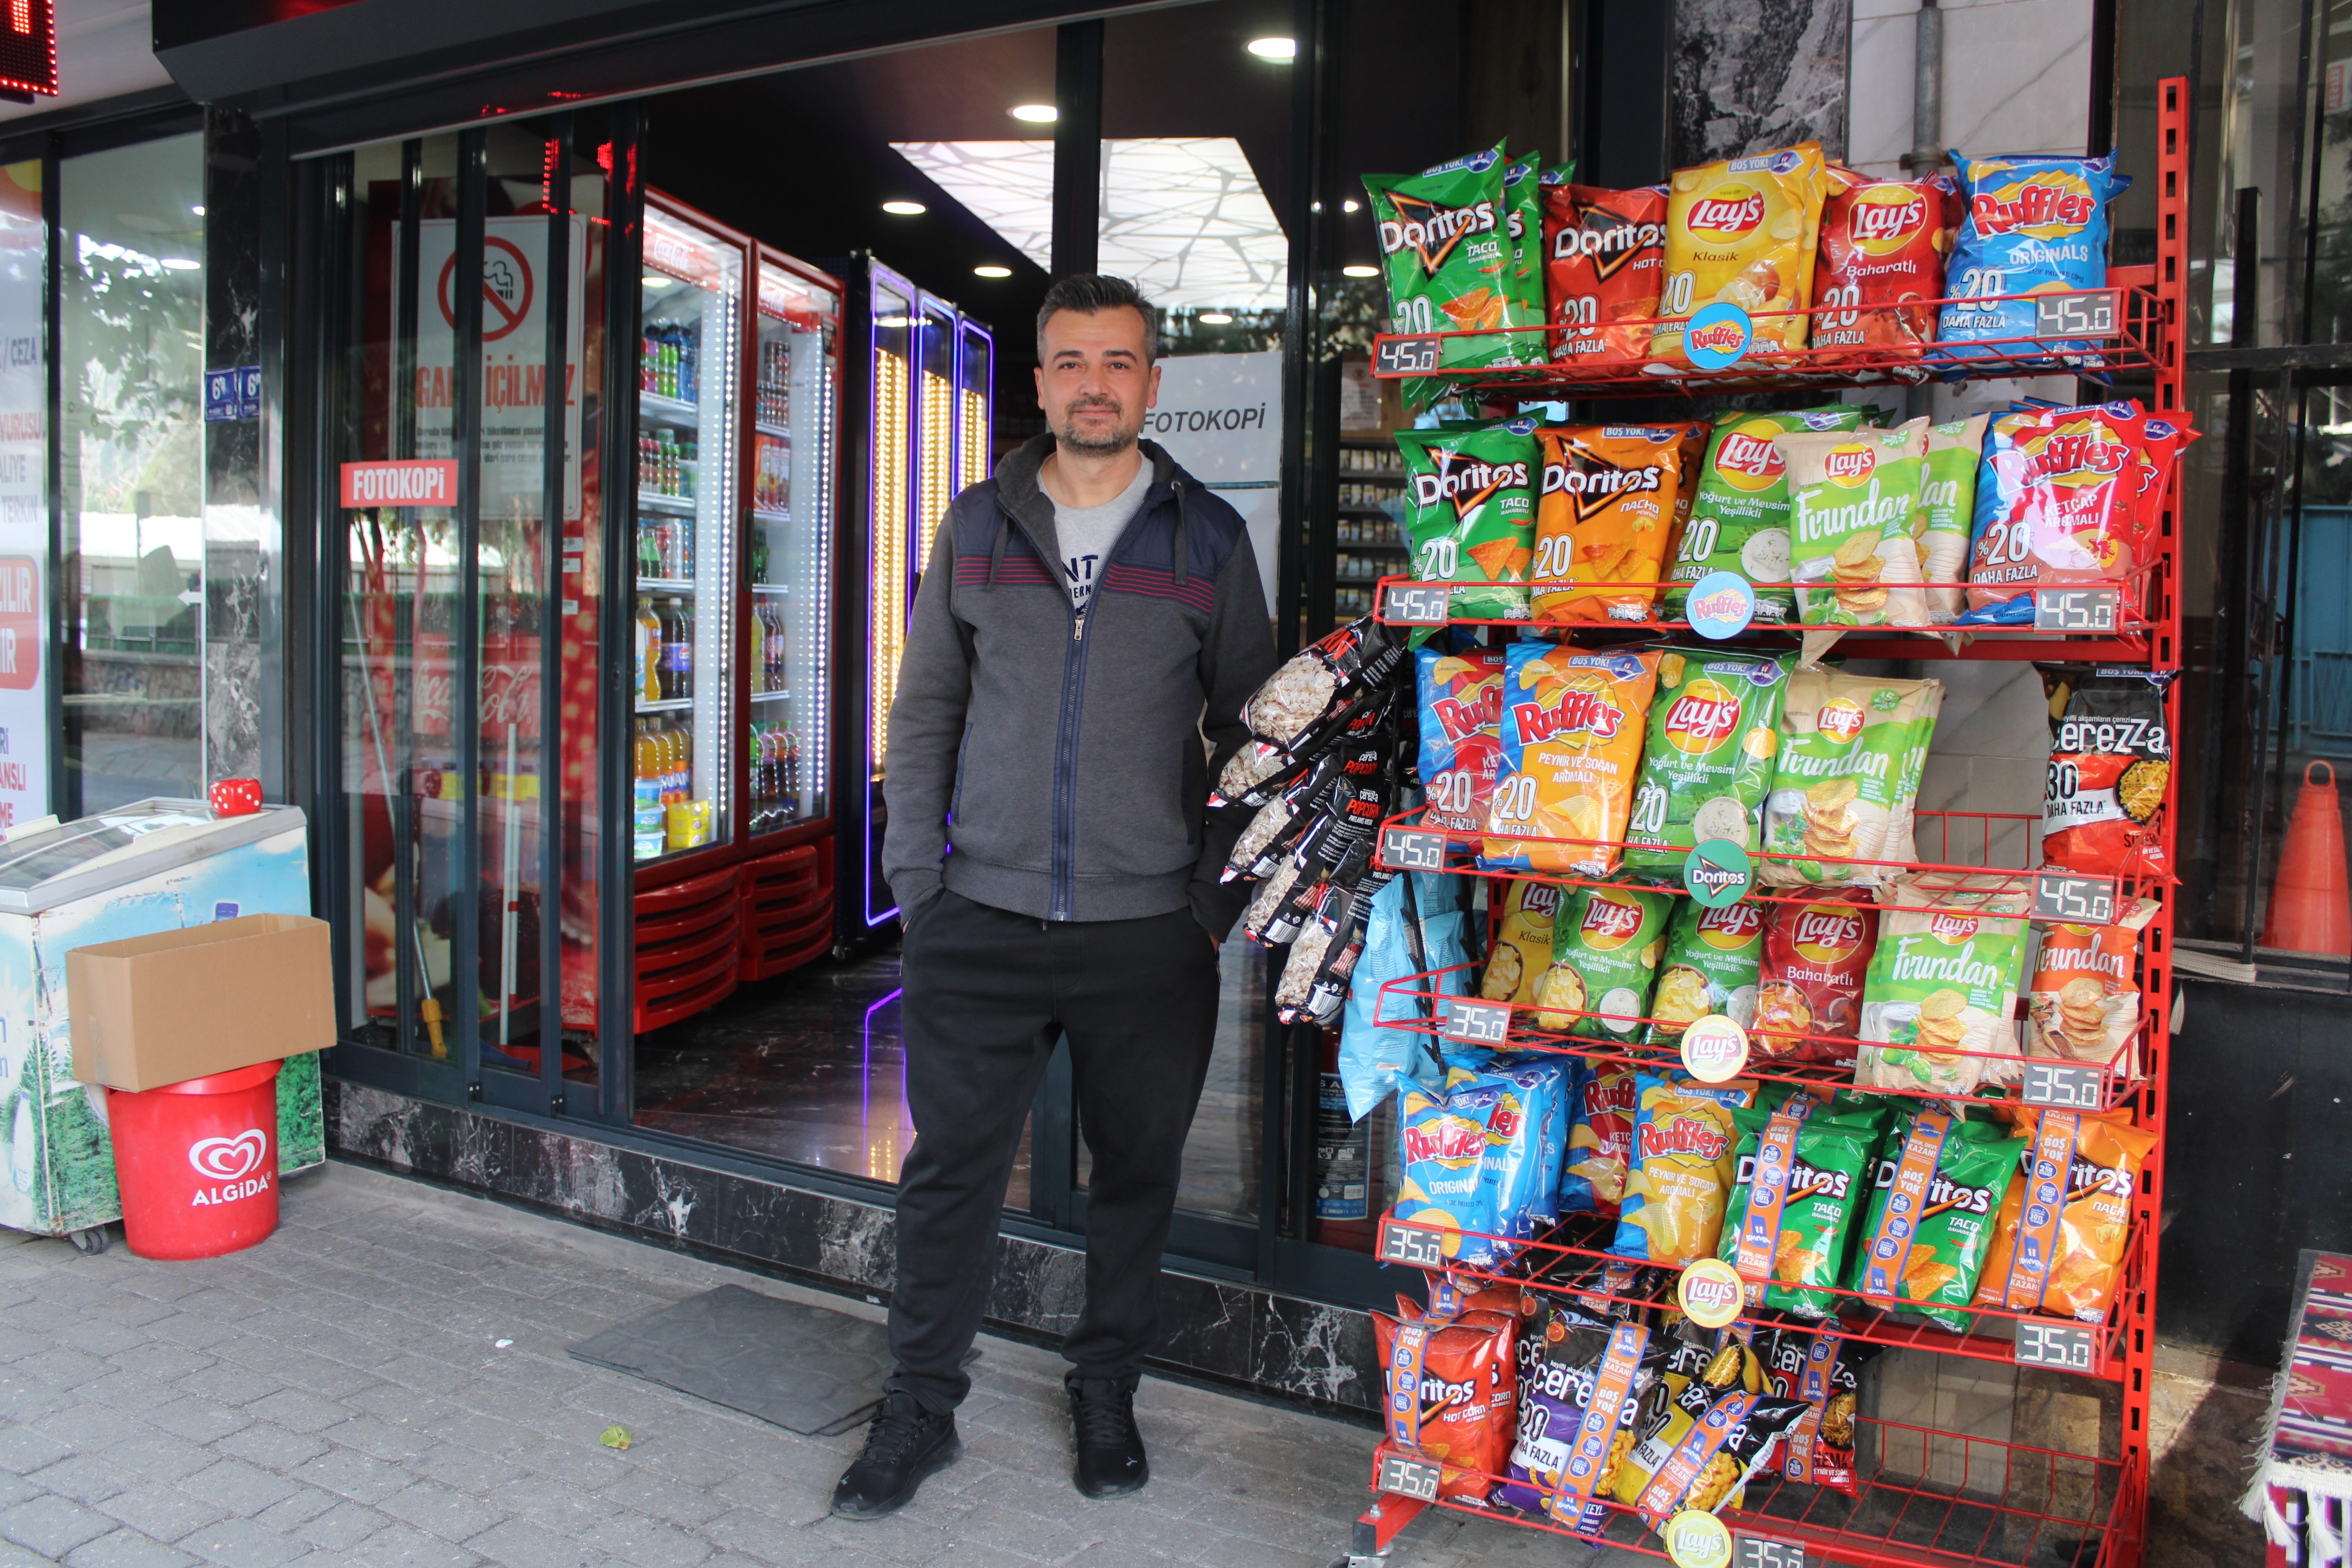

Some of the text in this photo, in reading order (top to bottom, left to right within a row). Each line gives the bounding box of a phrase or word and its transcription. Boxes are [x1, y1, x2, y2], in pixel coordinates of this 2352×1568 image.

[1731, 158, 1768, 171] BOŞ YOK!
[1691, 195, 1761, 233] Lay's
[1853, 198, 1923, 241] Lay's
[1968, 184, 2097, 242] Ruffles
[1378, 202, 1494, 254] Doritos
[1466, 241, 1498, 257] TACO
[1693, 251, 1739, 262] Klasik
[1633, 258, 1657, 270] HOT
[1846, 261, 1917, 277] Baharatlı
[1942, 315, 2006, 329] DAHA FAZLA
[1688, 325, 1747, 352] Ruffles
[1834, 328, 1864, 345] FAZLA
[1575, 339, 1606, 354] FAZLA
[485, 355, 576, 413] İÇİLMZ
[1139, 402, 1266, 433] FOTOKOPİ
[1606, 427, 1645, 438] BOŞ YOK!
[1829, 449, 1873, 478] Lay's
[1987, 433, 2129, 496] Ruffles
[1416, 463, 1530, 506] Doritos
[1542, 466, 1661, 495] Doritos
[1500, 498, 1530, 509] TACO
[1698, 491, 1790, 512] Yoğurt ve Mevsim
[2044, 495, 2098, 517] KETÇAP
[1719, 504, 1763, 520] Yeşillikli
[2005, 565, 2038, 580] FAZLA
[1691, 591, 1749, 622] Ruffles
[1487, 655, 1504, 664] BOŞ
[1572, 656, 1609, 667] BOŞ YOK!
[1707, 663, 1746, 673] BOŞ YOK!
[1510, 690, 1626, 747] Ruffles
[1666, 696, 1741, 737] Lay's
[1818, 709, 1863, 730] Lay's
[1571, 756, 1618, 775] VE SOĞAN
[1648, 757, 1736, 775] Yoğurt ve Mevsim
[1553, 772, 1593, 783] AROMALI
[1668, 769, 1709, 784] Yeşillikli
[1345, 798, 1381, 819] POPCORN
[2047, 801, 2103, 818] DAHA FAZLA
[1693, 869, 1746, 885] Doritos
[1583, 899, 1642, 935] Lay's
[1933, 912, 1978, 937] Lay's
[1518, 930, 1551, 945] Klasik
[1796, 912, 1861, 948] Lay's
[1565, 948, 1587, 960] Yoğurt
[1599, 955, 1632, 971] Mevsim
[1685, 949, 1711, 961] Yoğurt
[1725, 955, 1759, 968] Mevsim
[1703, 960, 1736, 972] Yeşillikli
[1579, 960, 1611, 974] Yeşillikli
[1786, 966, 1854, 986] Baharatlı
[1691, 1035, 1739, 1065] Lay's
[1402, 1123, 1486, 1166] Ruffles
[1639, 1117, 1730, 1161] Ruffles
[1769, 1132, 1789, 1144] YOK
[2044, 1137, 2066, 1151] BOŞ
[1907, 1144, 1937, 1158] KAZAN!
[2043, 1148, 2063, 1162] YOK
[1676, 1173, 1687, 1182] VE
[1902, 1170, 1925, 1184] BOŞ
[1660, 1185, 1695, 1198] AROMALI
[1900, 1180, 1921, 1196] YOK
[1813, 1202, 1841, 1217] TACO
[1949, 1216, 1980, 1232] TACO
[1737, 1255, 1768, 1269] KAZAN!
[1688, 1277, 1735, 1309] Lay's
[2010, 1279, 2040, 1292] KAZAN!
[1403, 1335, 1420, 1348] YOK
[1605, 1362, 1632, 1377] KAZAN!
[1599, 1388, 1620, 1403] BOŞ
[1596, 1399, 1617, 1415] YOK
[1443, 1413, 1462, 1423] HOT
[1793, 1433, 1810, 1446] BOŞ
[1530, 1446, 1560, 1469] FAZLA
[1792, 1443, 1808, 1458] YOK
[1666, 1461, 1690, 1483] KAZAN!
[1651, 1485, 1671, 1503] BOŞ
[1646, 1494, 1666, 1511] YOK
[1677, 1528, 1723, 1560] Lay's
